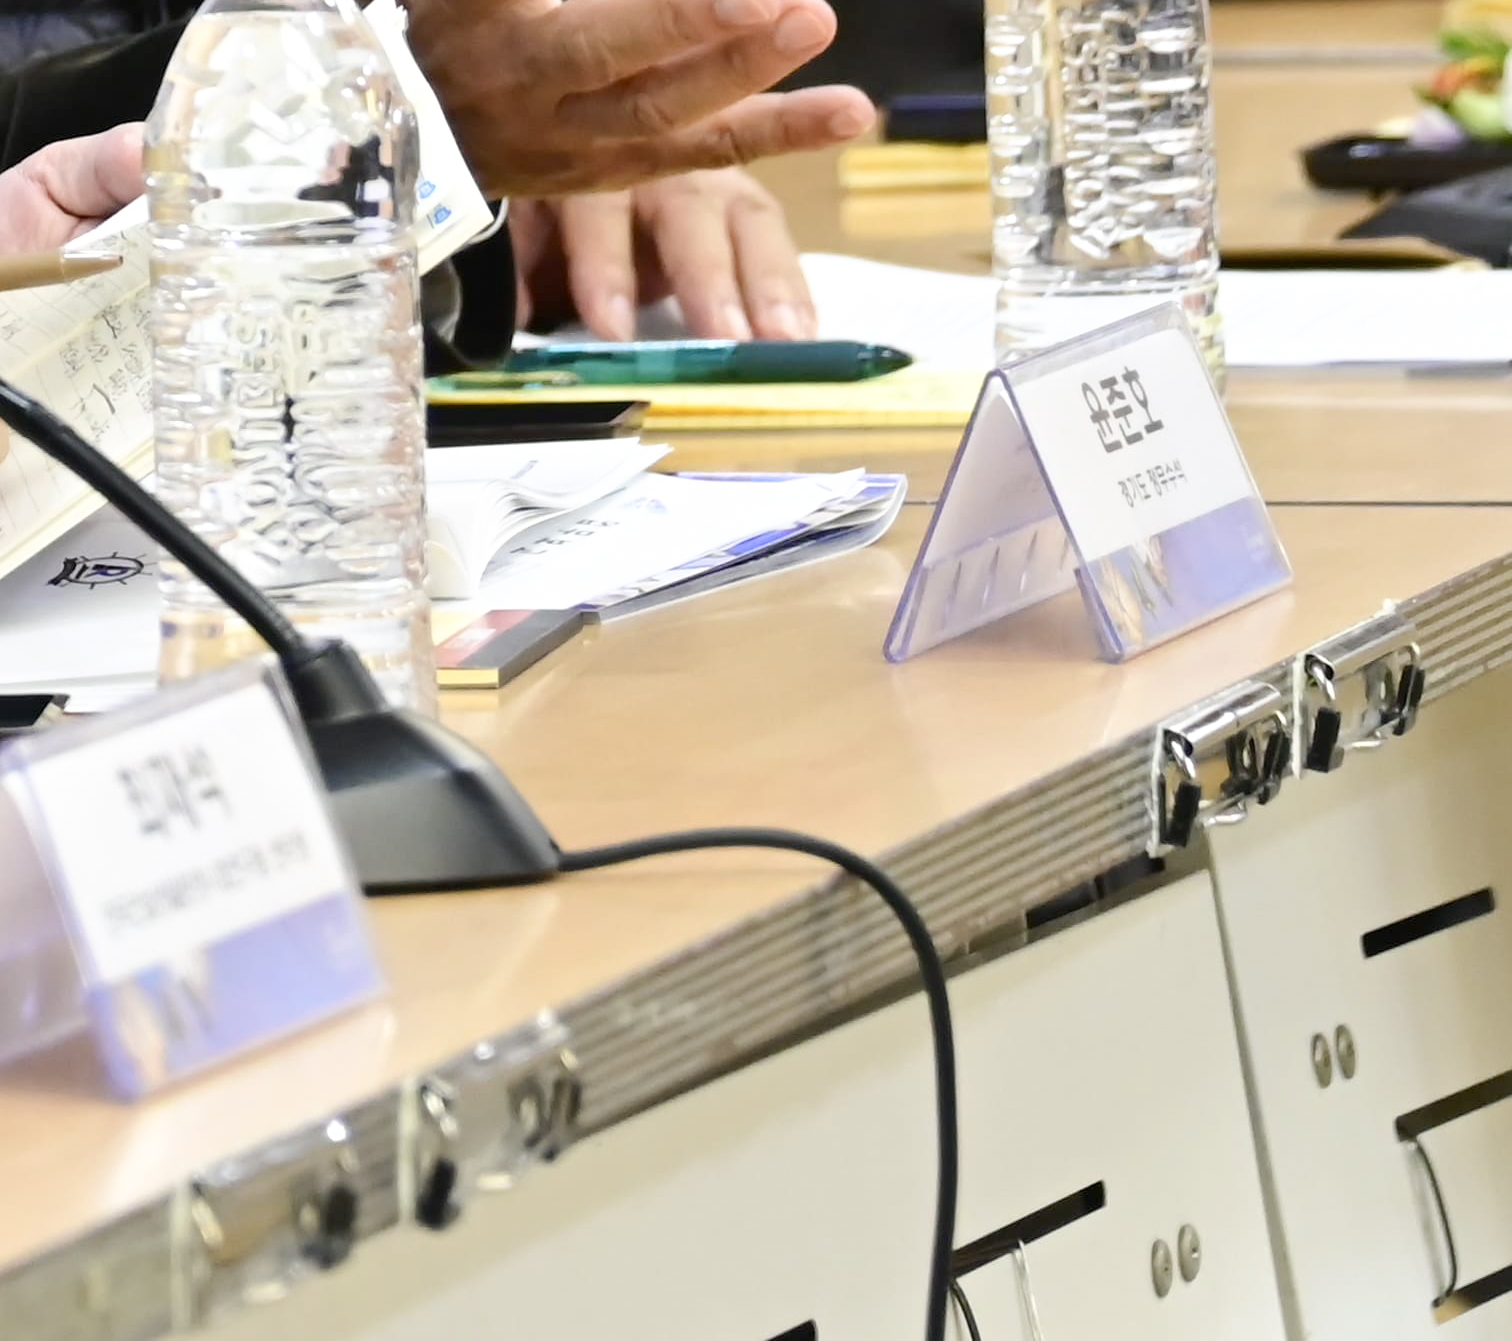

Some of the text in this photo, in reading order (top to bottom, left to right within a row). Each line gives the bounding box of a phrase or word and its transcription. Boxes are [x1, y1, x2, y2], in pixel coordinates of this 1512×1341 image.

[1081, 366, 1164, 453] 윤준호
[1117, 460, 1188, 508] 경기도 정무수석
